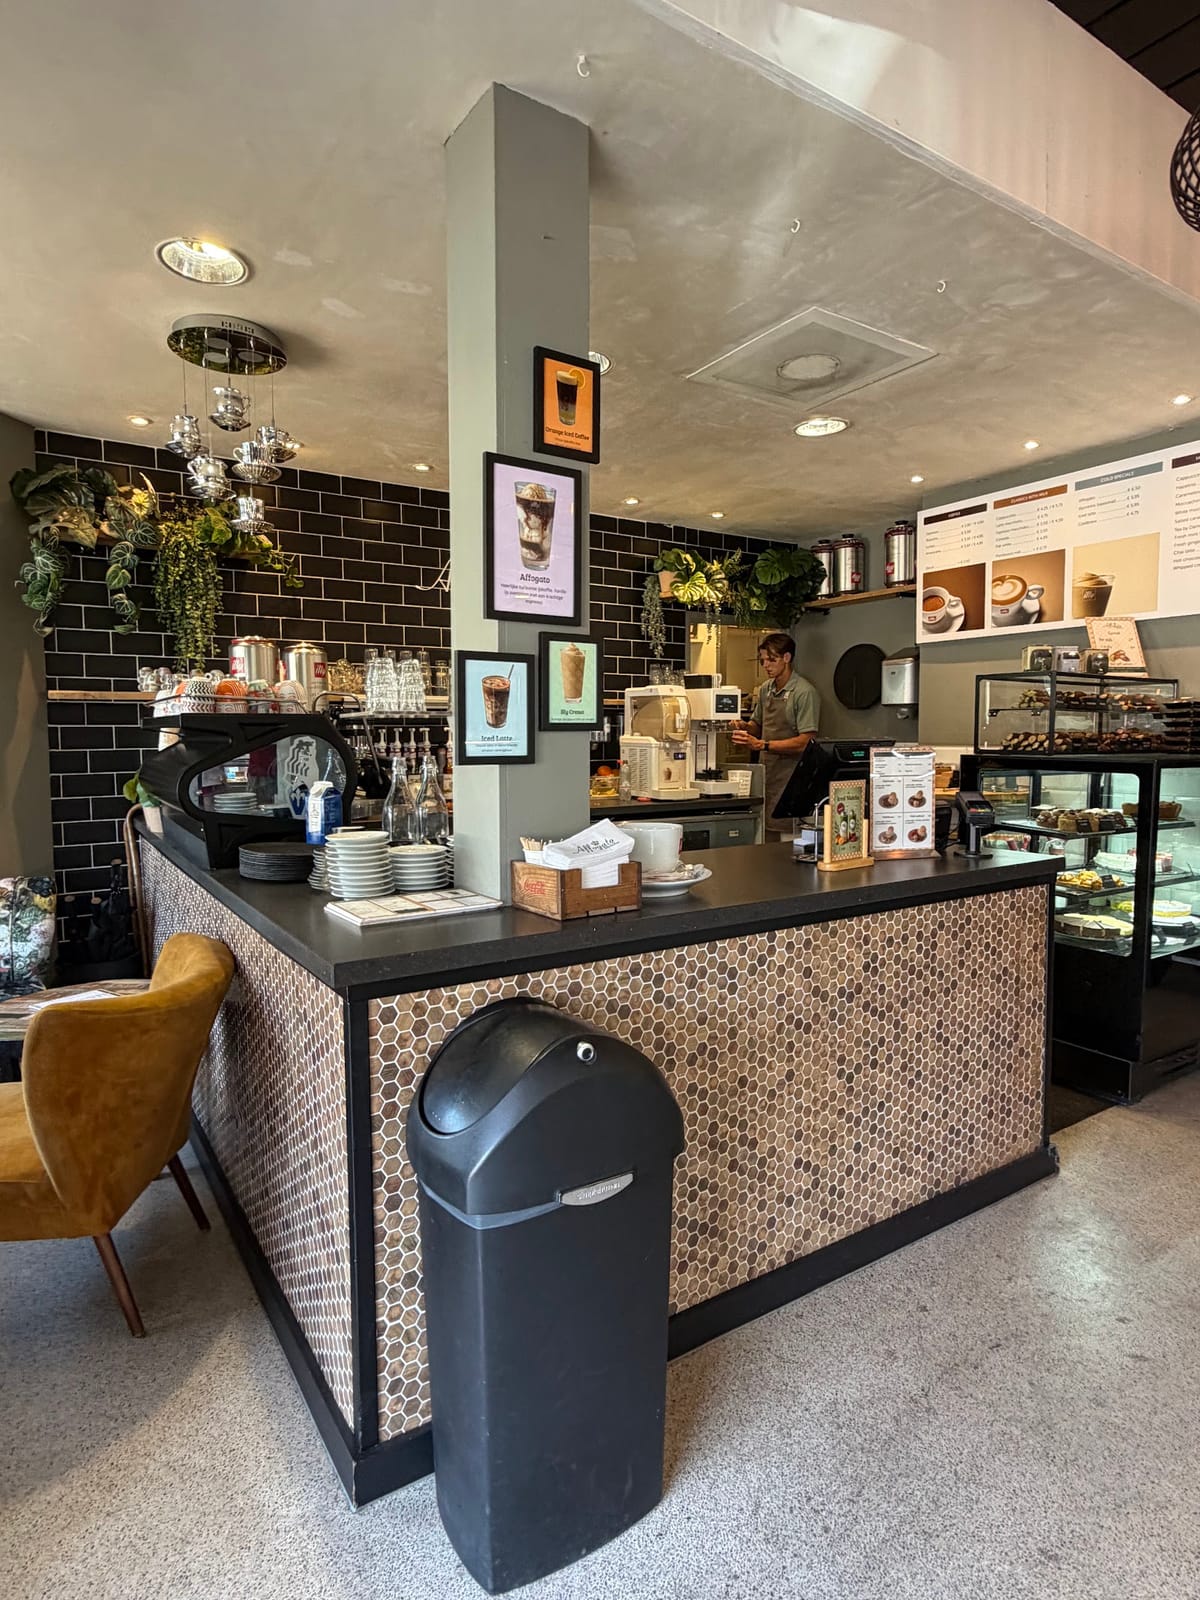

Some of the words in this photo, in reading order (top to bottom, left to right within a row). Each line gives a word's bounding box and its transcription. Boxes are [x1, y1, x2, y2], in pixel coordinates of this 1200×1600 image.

[545, 426, 564, 436] Orange
[575, 432, 590, 440] Coffee
[519, 573, 551, 584] Affogato
[573, 838, 620, 854] Affogato
